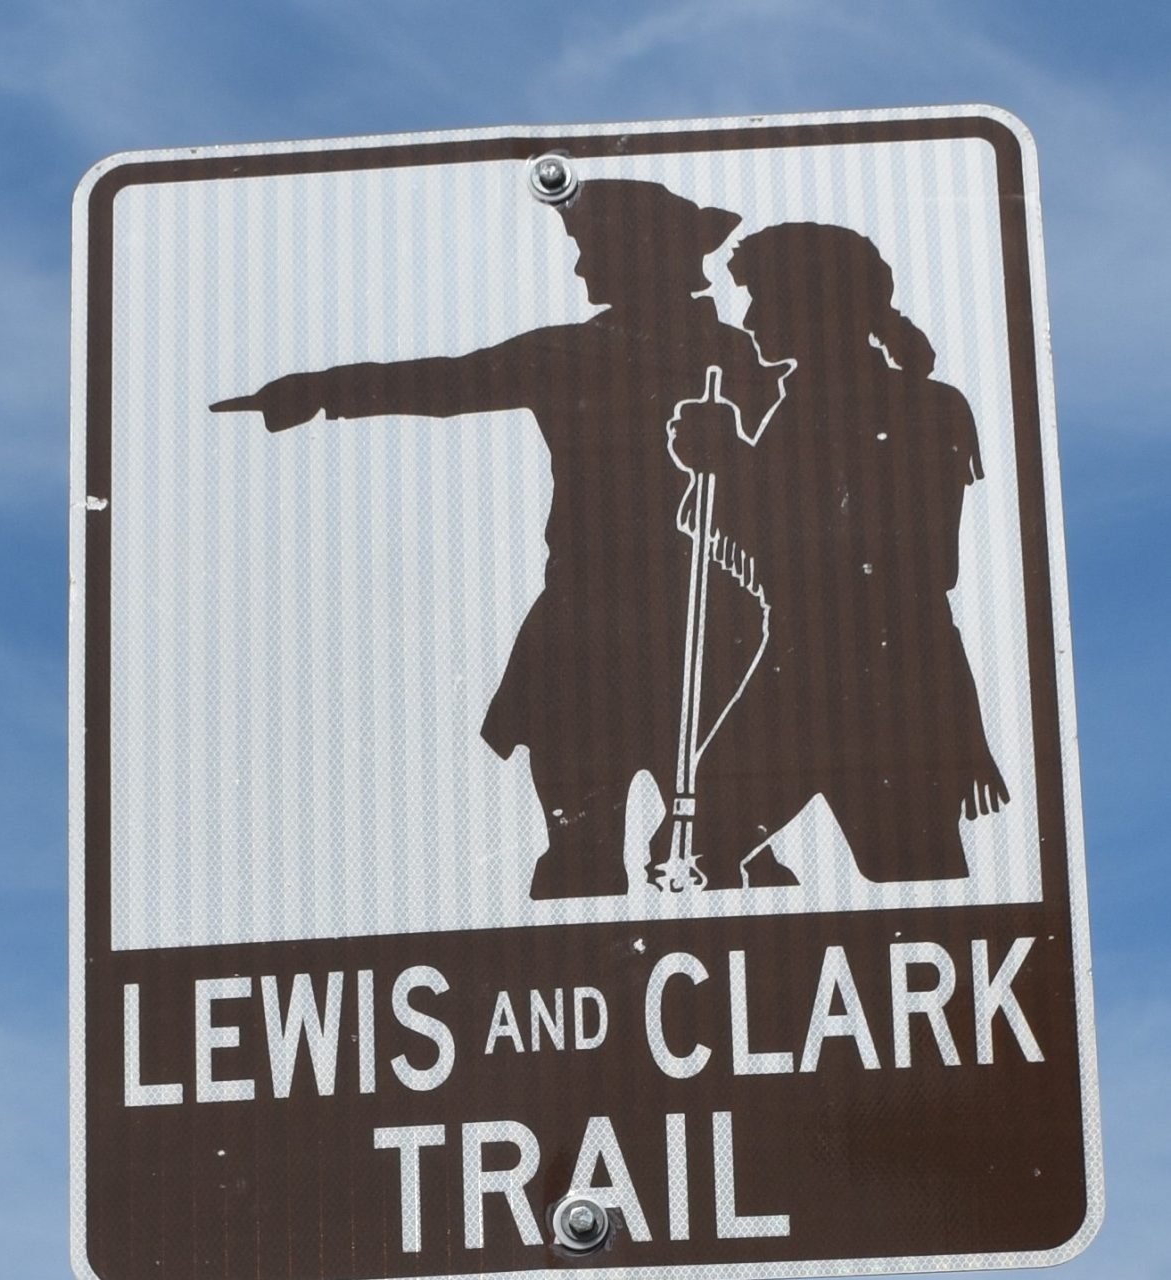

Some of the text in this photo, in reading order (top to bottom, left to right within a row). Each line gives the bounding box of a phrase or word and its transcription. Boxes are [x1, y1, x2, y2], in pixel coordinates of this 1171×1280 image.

[123, 936, 1045, 1107] LEWIS AND CLARK
[373, 1111, 791, 1253] TRAIL
